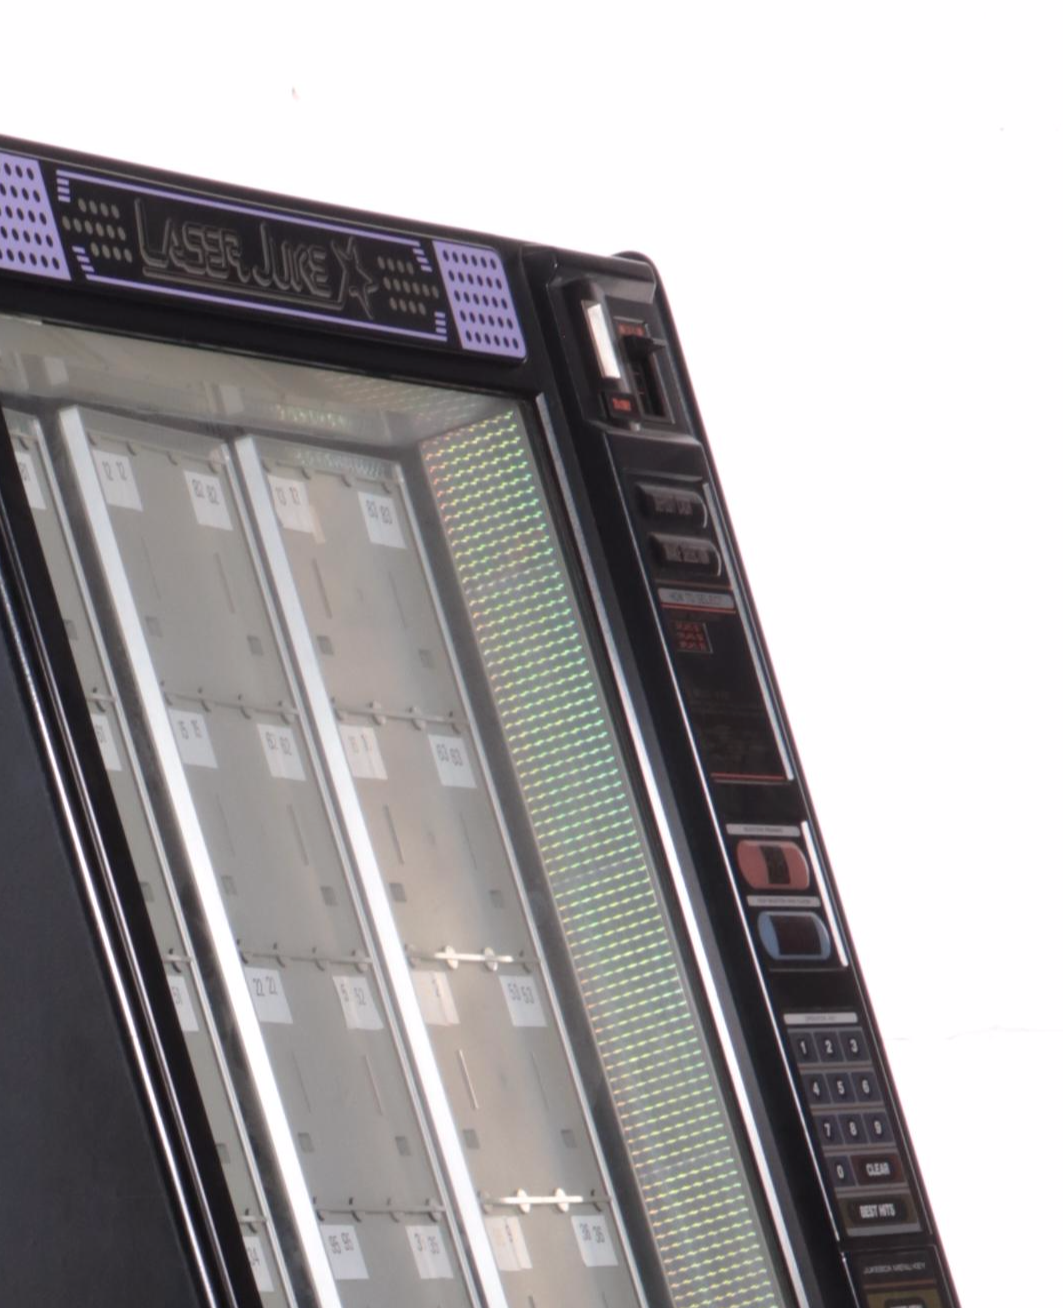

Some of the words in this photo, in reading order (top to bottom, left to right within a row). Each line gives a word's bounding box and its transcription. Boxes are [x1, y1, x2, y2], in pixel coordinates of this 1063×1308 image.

[133, 198, 250, 284] LASER
[252, 221, 332, 299] JUKE
[799, 1040, 808, 1055] 1
[824, 1039, 833, 1054] 2
[849, 1038, 858, 1053] 3
[812, 1082, 820, 1097] 4
[836, 1080, 845, 1095] 5
[861, 1079, 870, 1094] 6
[823, 1122, 832, 1137] 7
[848, 1121, 857, 1136] 8
[873, 1120, 882, 1135] 9
[836, 1165, 844, 1179] 0
[865, 1162, 890, 1177] CLEAR
[859, 1204, 878, 1219] BEST
[878, 1203, 896, 1217] HITS
